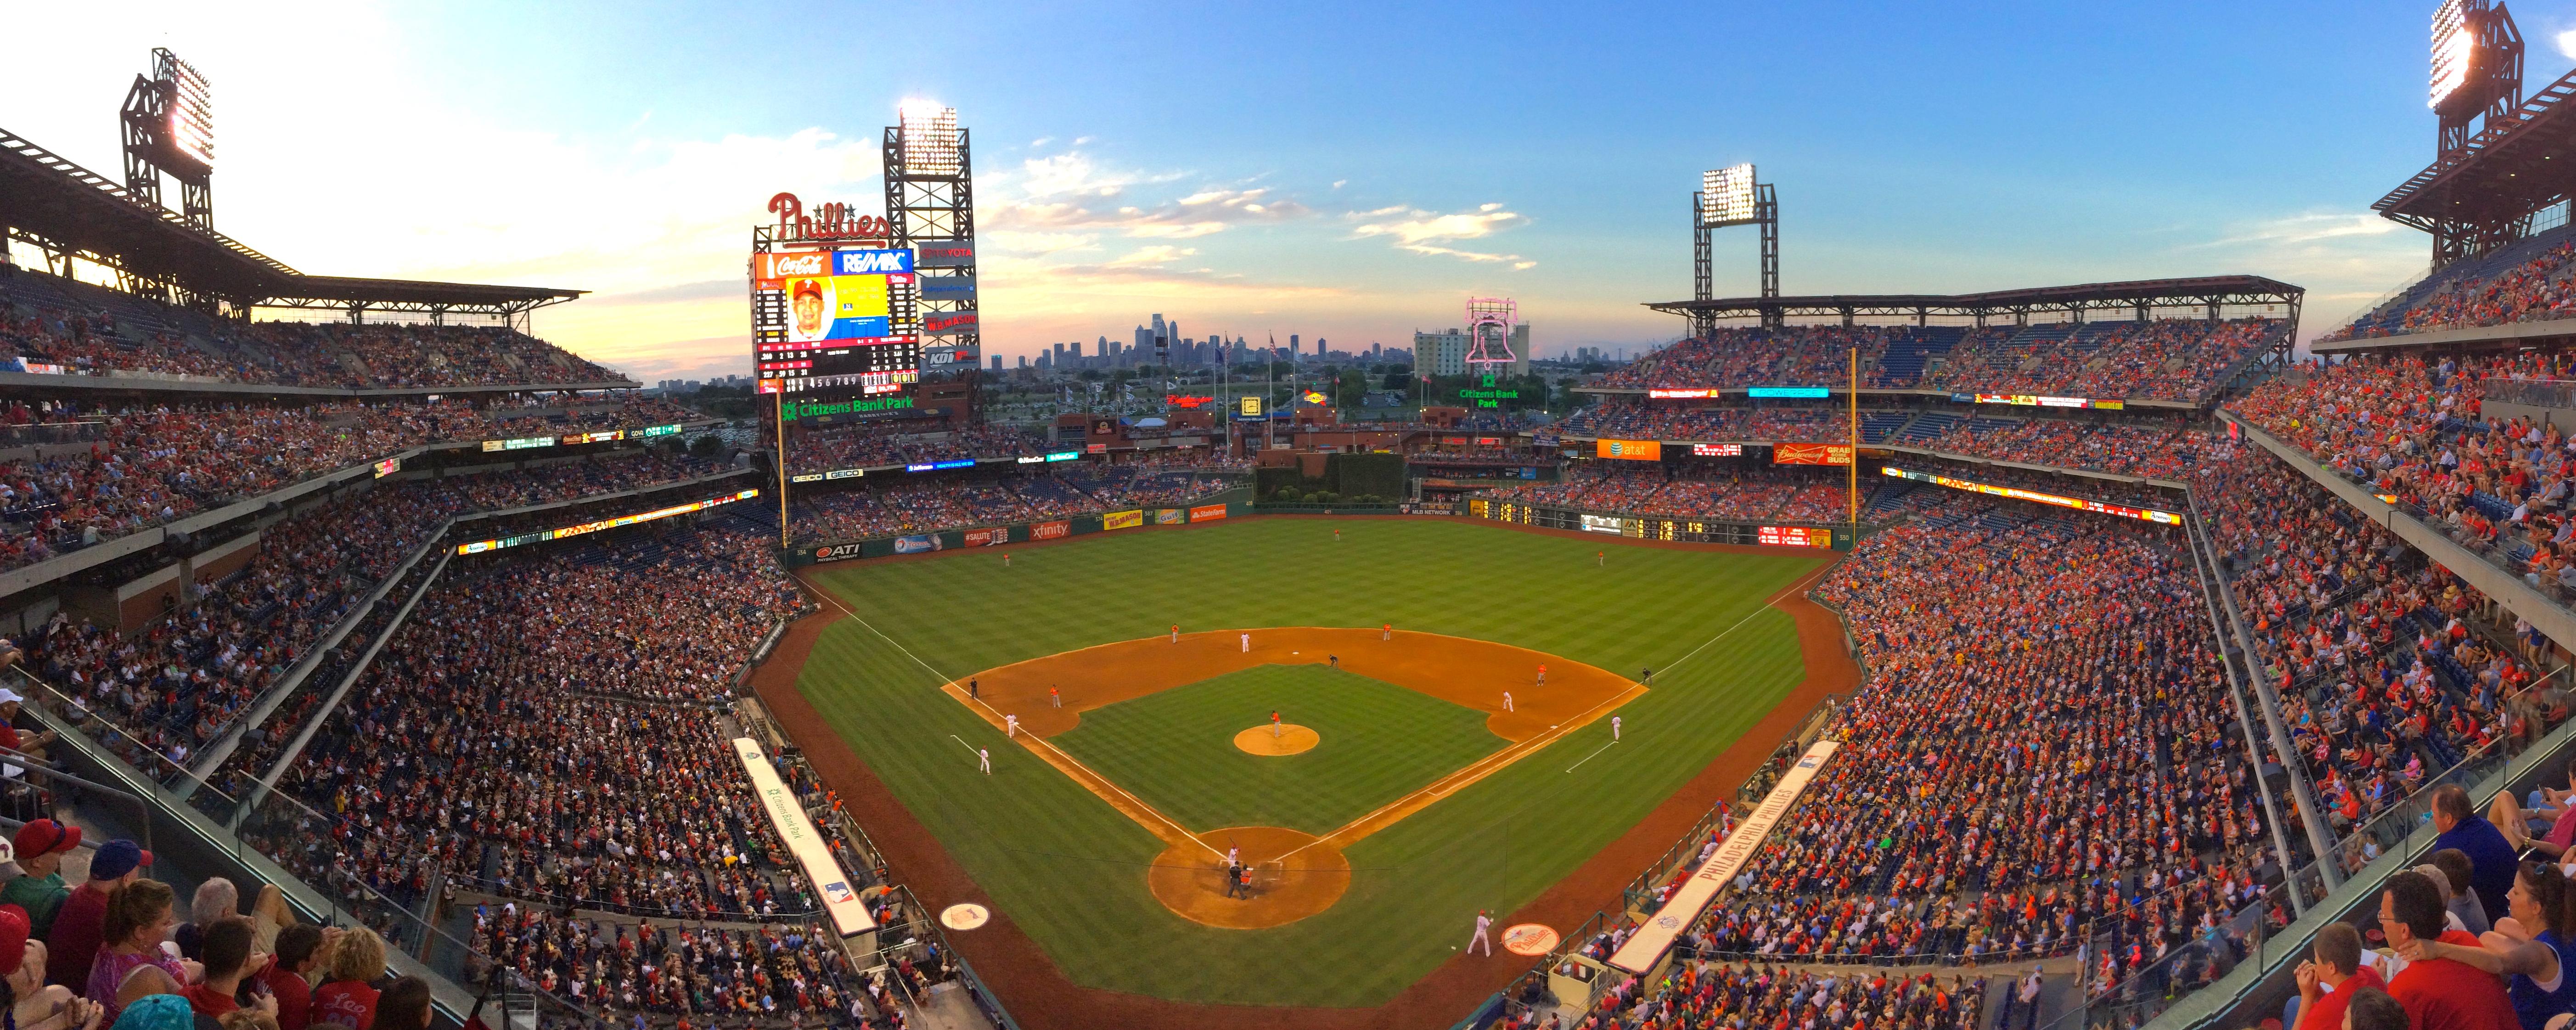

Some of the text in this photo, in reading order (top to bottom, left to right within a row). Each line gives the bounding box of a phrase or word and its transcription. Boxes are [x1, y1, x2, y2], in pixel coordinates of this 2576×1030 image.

[768, 192, 890, 240] Phillies
[933, 249, 973, 257] TOYOTA
[843, 253, 904, 273] RE/MAX
[929, 353, 955, 365] KDI
[836, 377, 841, 386] 7
[894, 374, 899, 383] 0
[1460, 389, 1518, 399] Citizens Bank
[800, 395, 914, 417] Citizens Bank Park
[1478, 399, 1498, 408] Park
[1625, 445, 1645, 456] at&t
[1776, 449, 1825, 458] Budweiser
[831, 470, 859, 478] GEICO
[1160, 511, 1179, 523] Gulf
[966, 532, 990, 540] #SALUTE
[1033, 522, 1068, 539] xfinity
[831, 544, 860, 556] ATI
[772, 796, 804, 840] Citizens Bank Park
[1699, 789, 1793, 881] PHILADELPHIA PHILLIES
[1510, 929, 1549, 951] Phillies
[324, 992, 366, 1016] Lee
